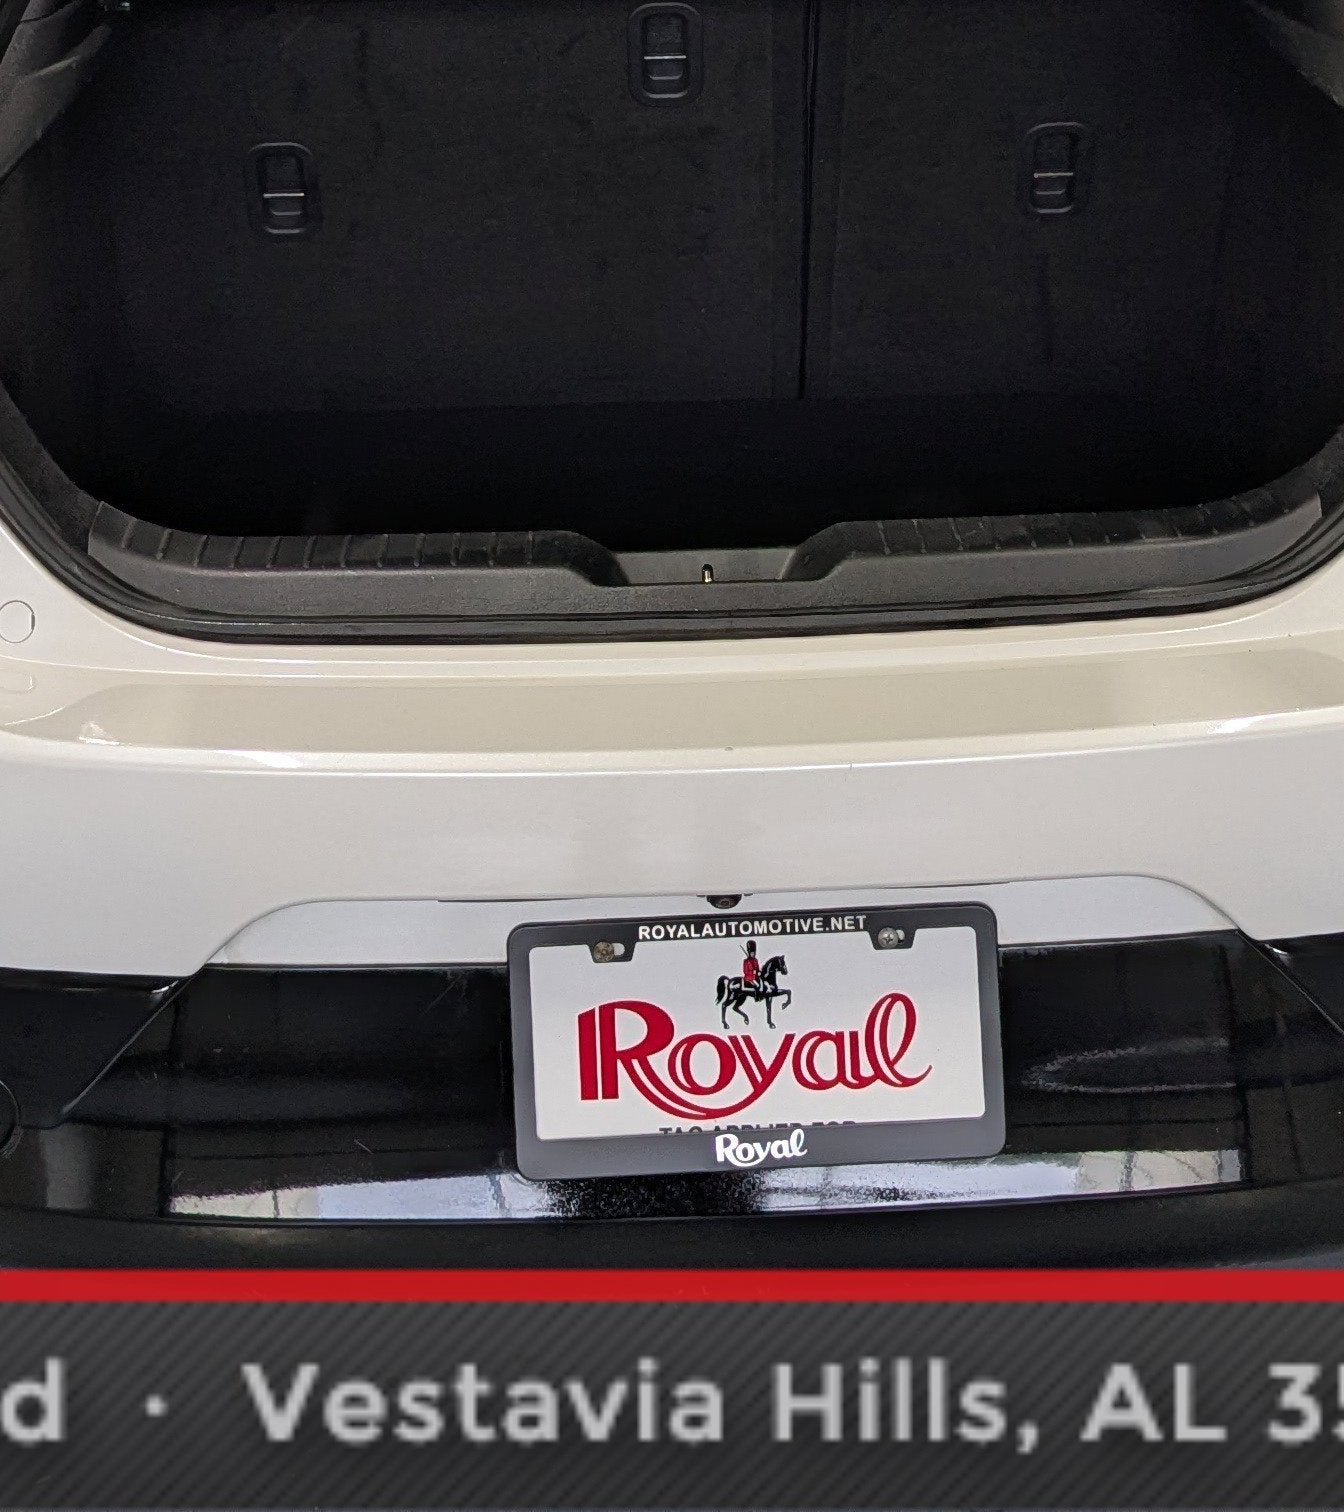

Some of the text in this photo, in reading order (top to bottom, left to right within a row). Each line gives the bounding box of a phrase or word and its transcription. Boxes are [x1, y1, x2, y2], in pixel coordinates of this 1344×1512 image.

[638, 915, 867, 940] ROYALAUTOMOTIVE.NET
[577, 992, 933, 1120] Royal
[715, 1128, 808, 1167] Royal
